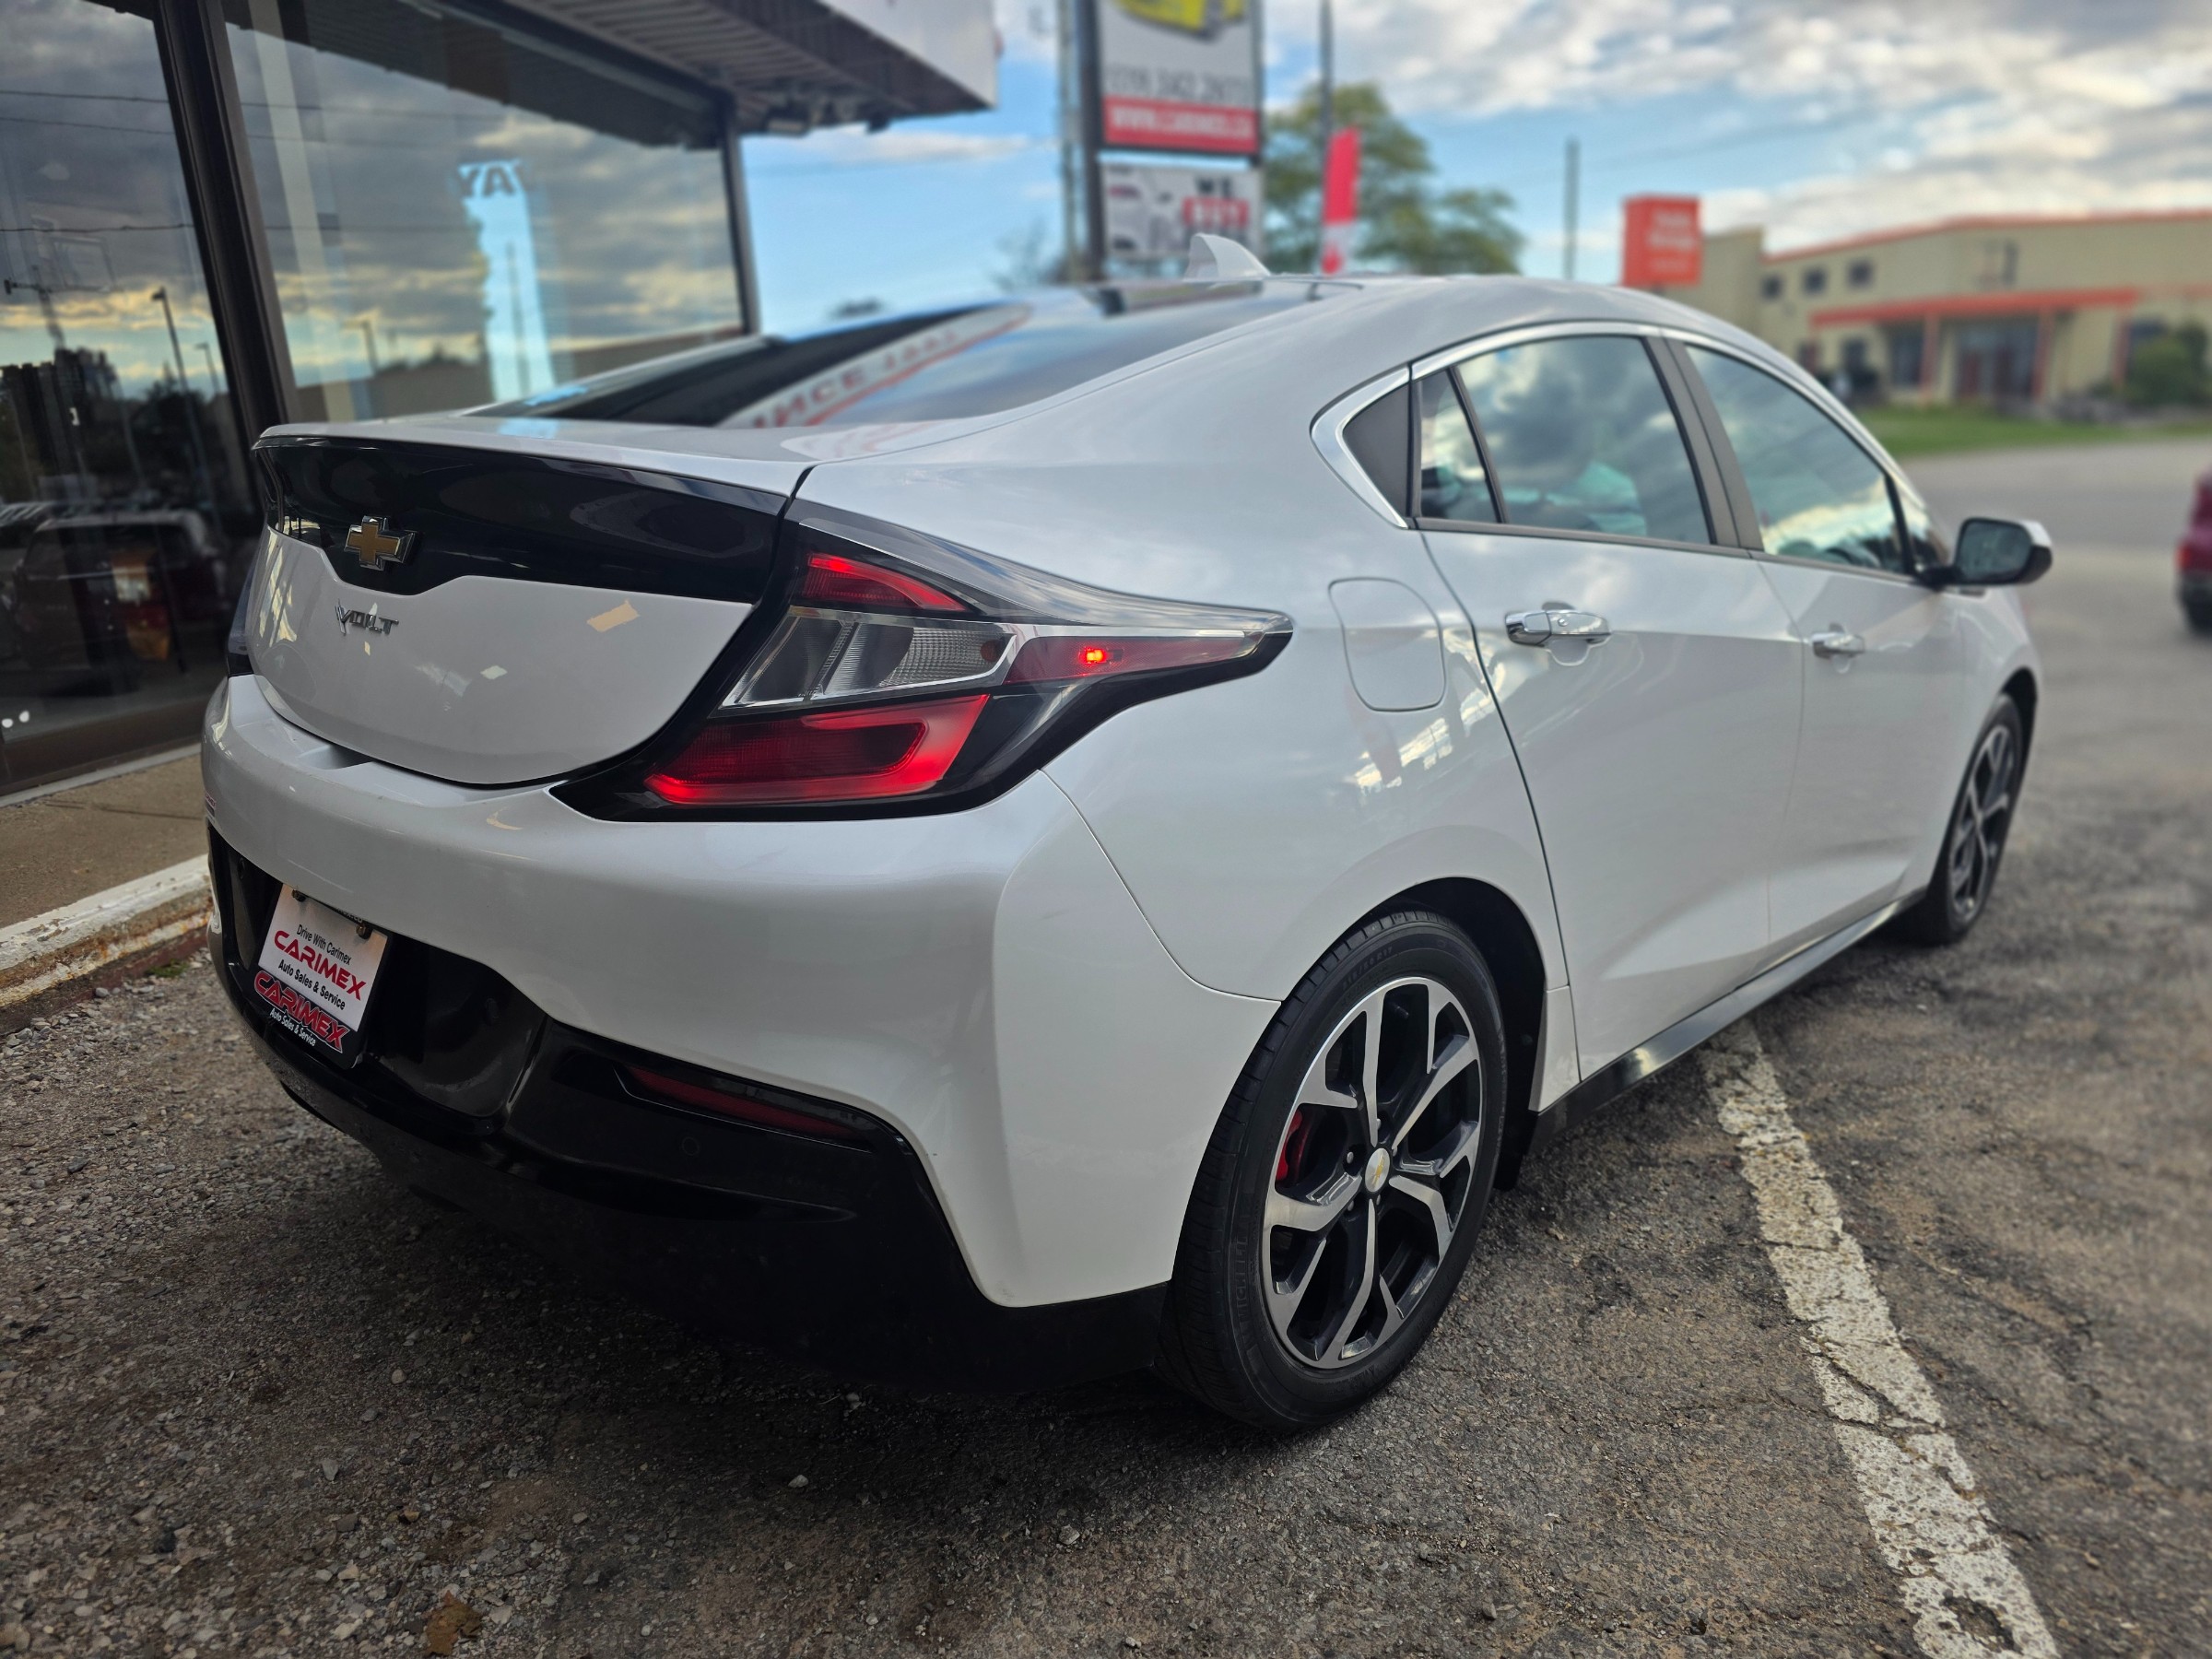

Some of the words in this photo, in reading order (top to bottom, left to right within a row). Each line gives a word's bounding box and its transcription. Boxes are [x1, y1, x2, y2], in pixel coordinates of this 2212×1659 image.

[335, 601, 399, 636] VOLT
[275, 930, 366, 1001] CARIMEX
[296, 924, 312, 942] Drive
[313, 934, 326, 951] With
[326, 943, 351, 965] Carimex
[278, 959, 294, 977] Auto
[295, 969, 312, 989] Sales
[313, 981, 320, 994] &
[320, 985, 346, 1010] Service
[254, 971, 350, 1053] CARIMEX
[270, 1007, 282, 1021] Auto
[282, 1015, 294, 1030] Sales
[294, 1024, 300, 1033] &
[299, 1027, 316, 1047] Service
